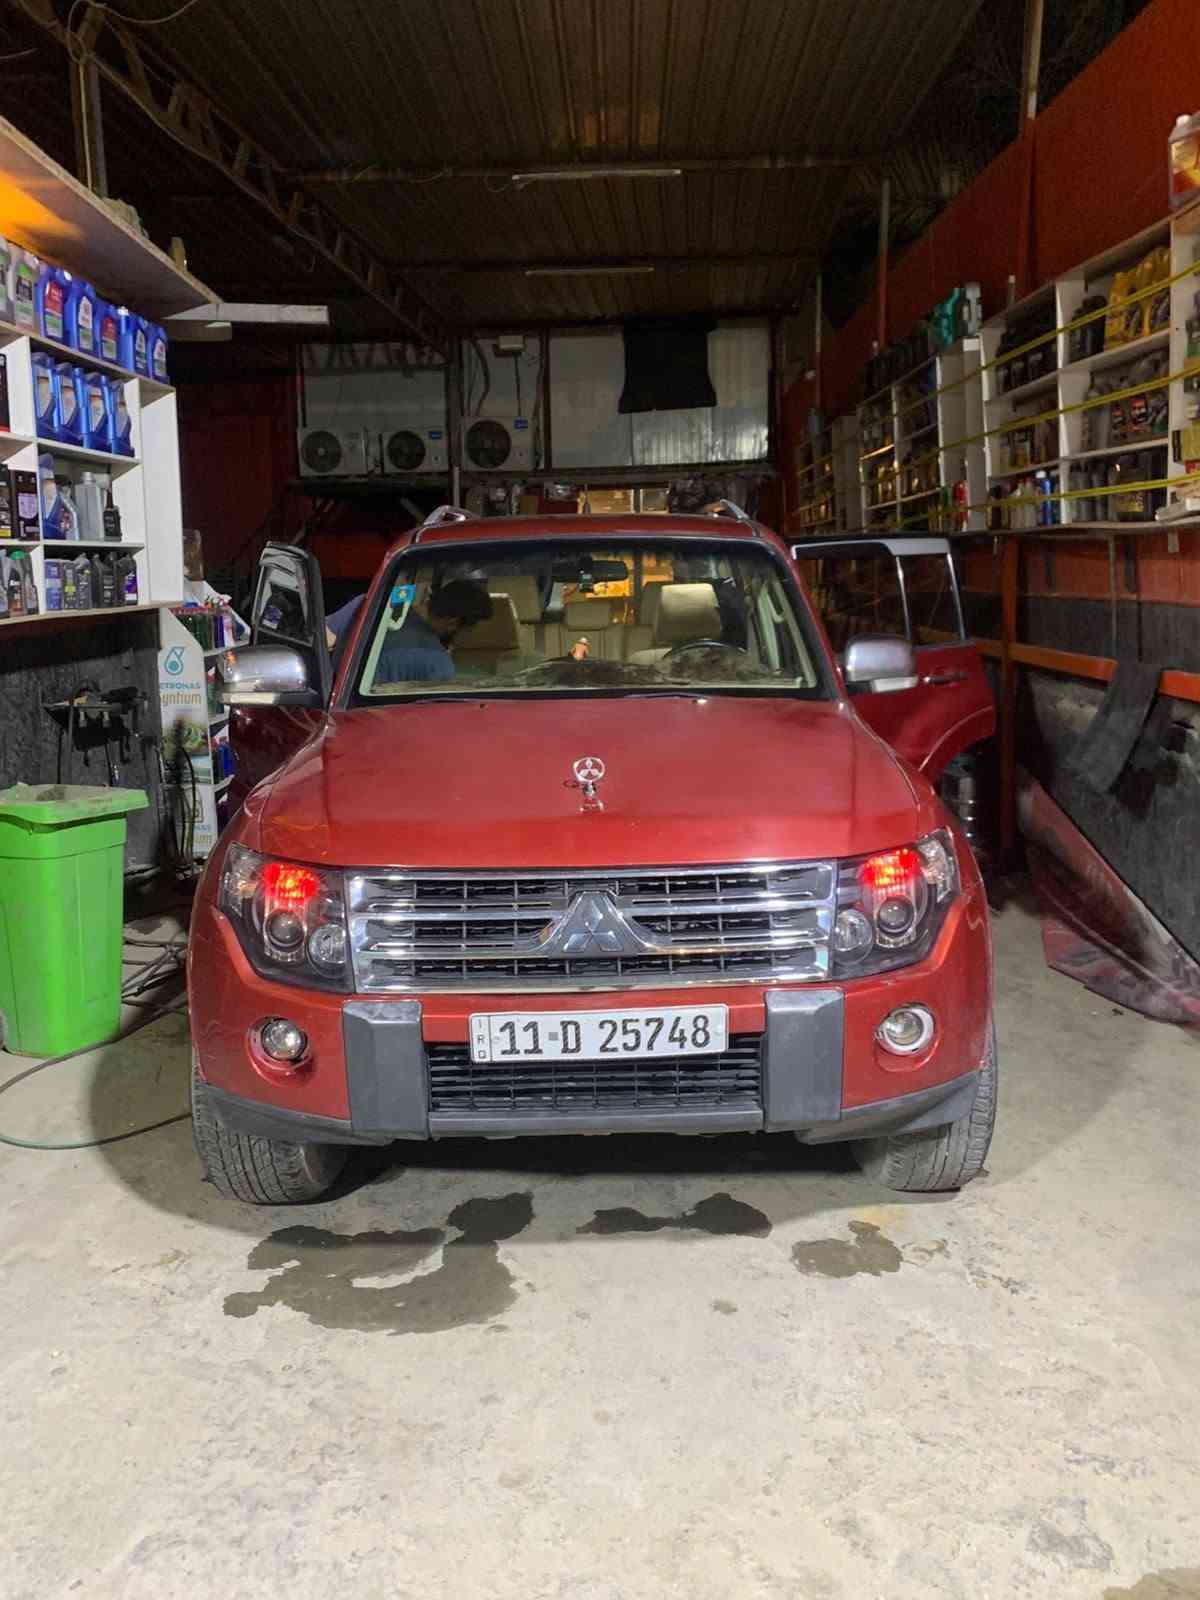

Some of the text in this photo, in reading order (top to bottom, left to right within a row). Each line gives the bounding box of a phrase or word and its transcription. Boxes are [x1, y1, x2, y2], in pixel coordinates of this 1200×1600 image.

[160, 681, 201, 690] ETRONAS
[161, 692, 202, 707] yntium
[499, 1014, 711, 1055] 11 D 25748
